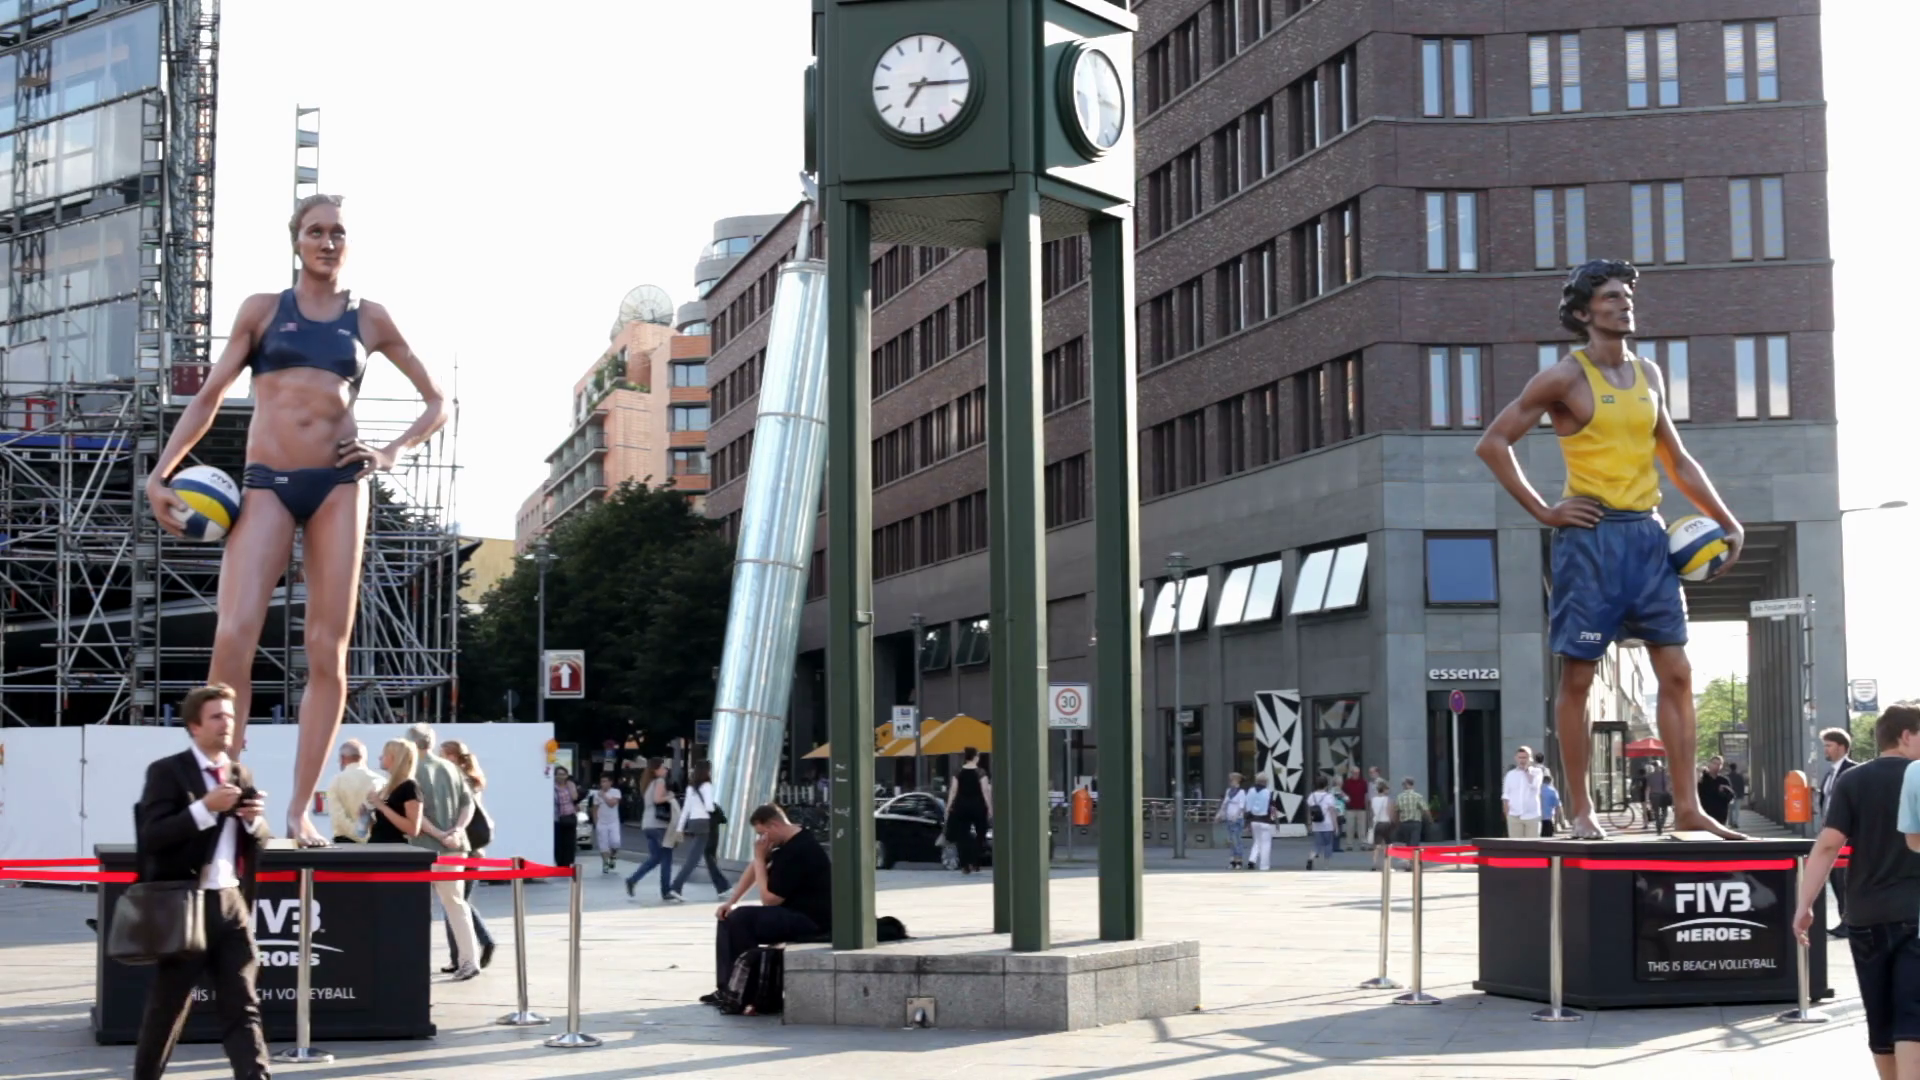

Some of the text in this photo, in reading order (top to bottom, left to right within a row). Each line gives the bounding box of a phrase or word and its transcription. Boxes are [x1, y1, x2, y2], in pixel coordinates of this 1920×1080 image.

[1429, 668, 1500, 680] essenza
[1061, 695, 1077, 709] 30
[1675, 881, 1752, 913] FIVB
[1676, 927, 1752, 943] HEROES
[1648, 958, 1777, 972] THIS IS BEACH VOLLEYBALL
[276, 987, 356, 1000] VOEYBALL
